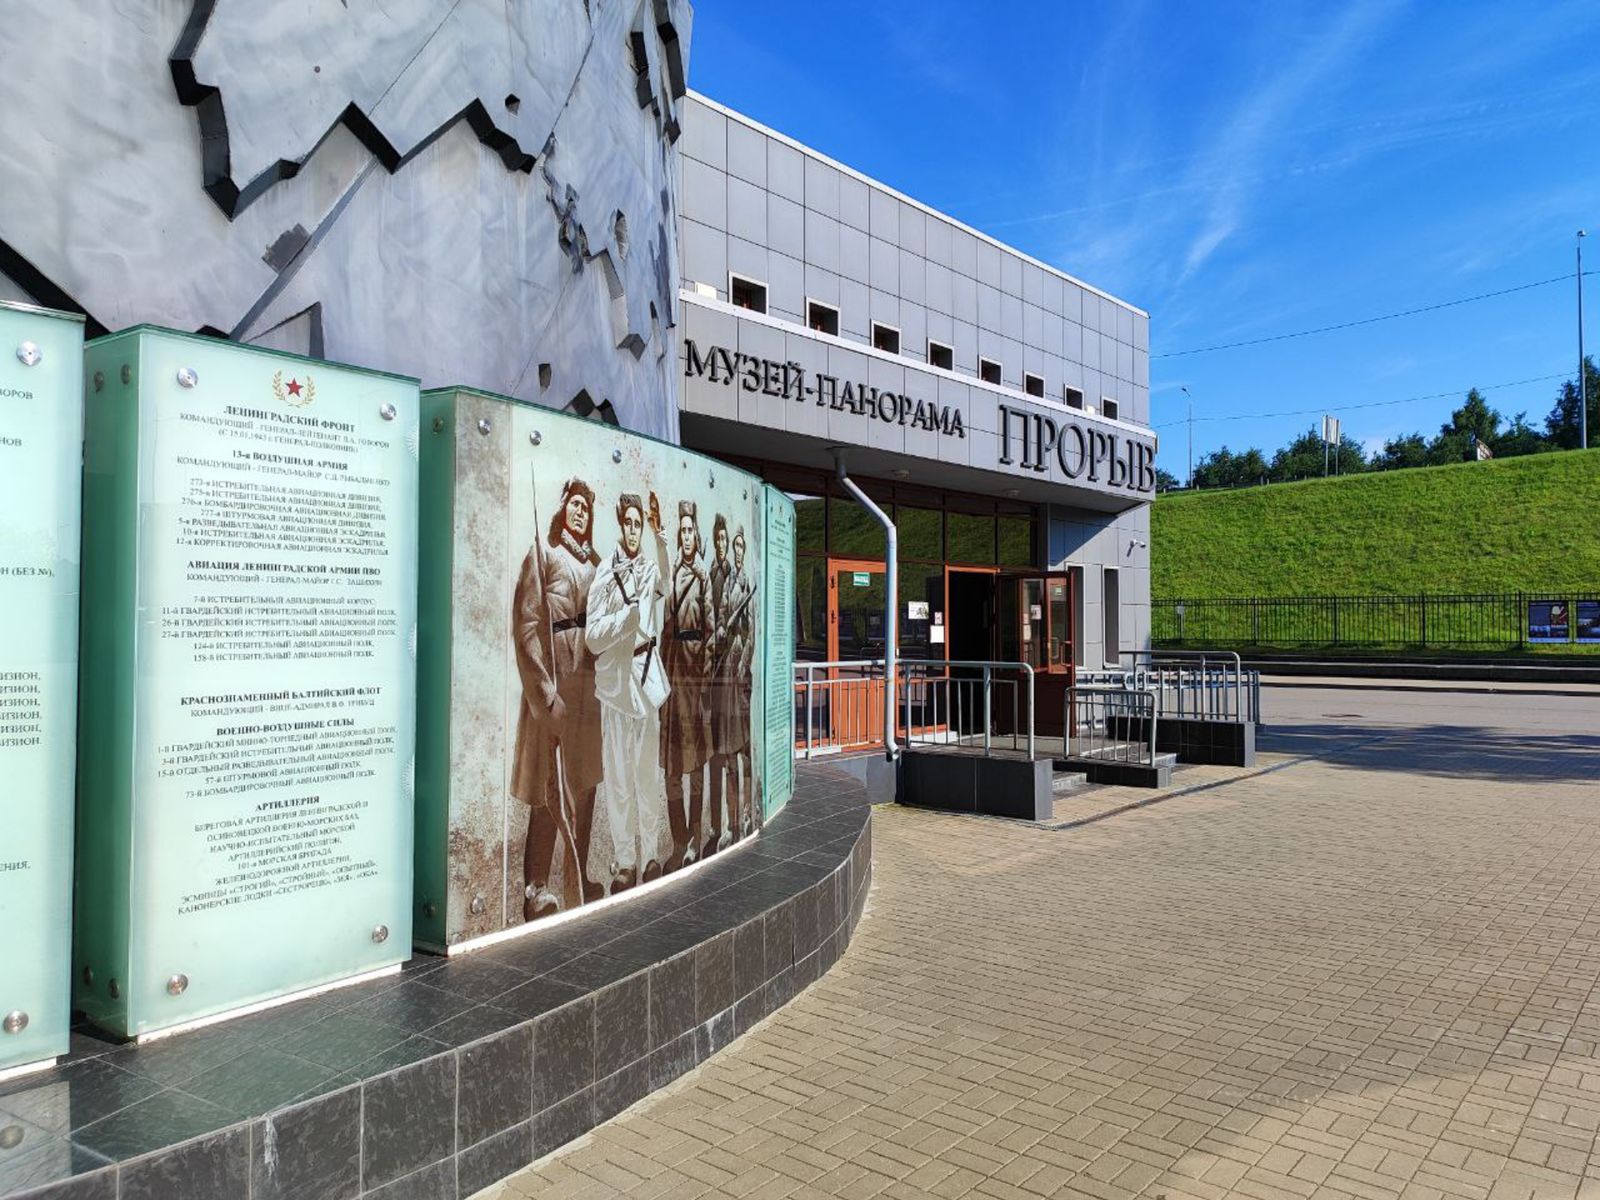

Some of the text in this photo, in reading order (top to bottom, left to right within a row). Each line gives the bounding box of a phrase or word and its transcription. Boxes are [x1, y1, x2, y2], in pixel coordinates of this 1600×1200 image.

[223, 406, 355, 432] ЛЕНИНГРАДСКИЙ ФРОНТ
[684, 339, 1157, 491] МУЗЕЙ-ПАНОРАМА ПРОРЫВ
[176, 455, 250, 471] КОМАНДУЮЩИЙ
[232, 450, 348, 471] 13-я ВОЗДУШНАЯ АРМИЯ
[221, 510, 275, 521] ШТУРМОВАЯ
[11, 567, 35, 576] (БЕЗ
[186, 560, 380, 575] АВИАЦИЯ ЛЕНИНГРАДСКОЙ АРМИИ ПВО
[186, 573, 259, 583] КОМАНДУЮЩИЙ
[207, 595, 283, 603] ИСТРЕБИТЕЛЬНЫЙ
[180, 606, 242, 615] ГВАРДЕЙСКИЙ
[244, 606, 316, 615] ИСТРЕБИТЕЛЬНЫЙ
[181, 617, 243, 627] ГВАРДЕЙСКИЙ
[244, 617, 317, 626] ИСТРЕБИТЕЛЬНЫЙ
[180, 629, 242, 638] ГВАРДЕЙСКИЙ
[244, 628, 316, 637] ИСТРЕБИТЕЛЬНЫЙ
[215, 639, 291, 649] ИСТРЕБИТЕЛЬНЫЙ
[215, 650, 291, 661] ИСТРЕБИТЕЛЬНЫЙ
[180, 686, 382, 705] КРАСНОЗНАМЕННЫЙ БАЛТИЙСКИЙ ФЛОТ
[216, 718, 354, 735] ВОЕННО-ВОЗДУШНЫЕ СИЛЫ
[171, 738, 234, 751] ГВАРДЕЙСКИЙ
[176, 749, 239, 763] ГВАРДЕЙСКИЙ
[255, 795, 320, 811] АРТИЛЛЕРИЯ
[194, 818, 243, 832] БЕРЕГОВАЯ
[319, 822, 355, 836] МОРСКОЙ
[258, 853, 297, 866] МОРСКАЯ
